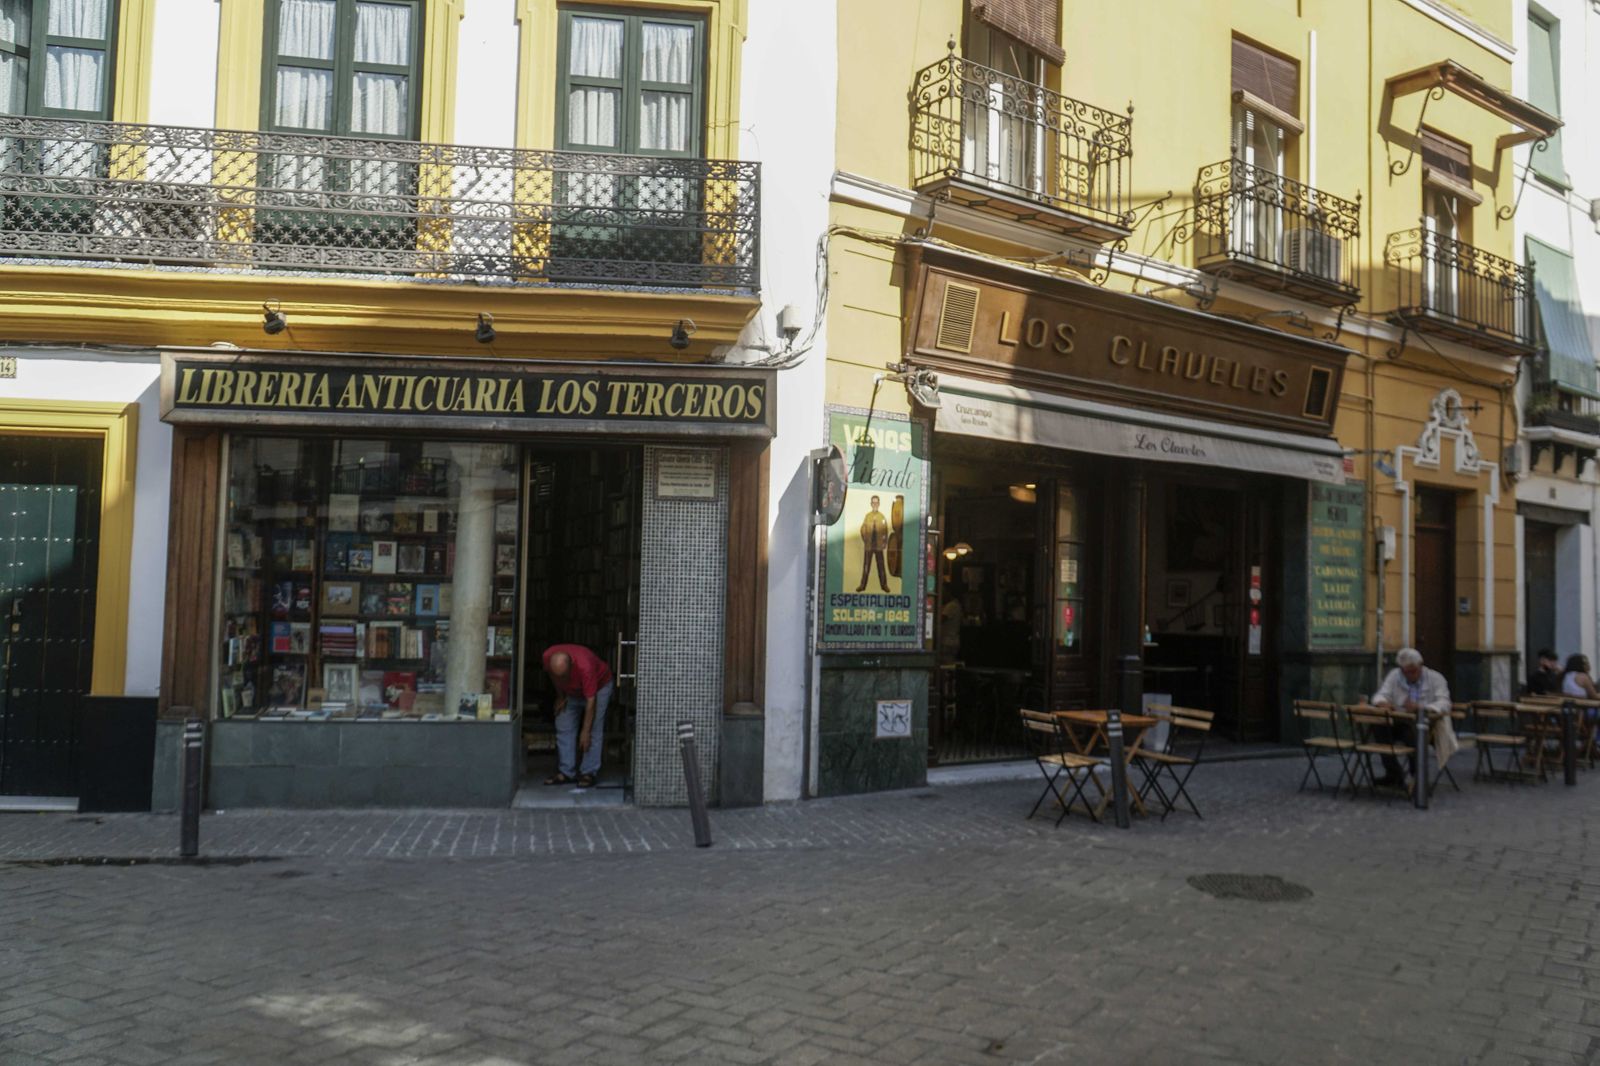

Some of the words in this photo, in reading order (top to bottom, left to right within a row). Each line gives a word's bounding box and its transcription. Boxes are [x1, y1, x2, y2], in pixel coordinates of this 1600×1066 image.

[999, 310, 1076, 354] LOS
[1111, 335, 1289, 397] CLAVELES
[176, 368, 331, 408] LIBRERIA
[336, 374, 525, 413] ANTICUARIA
[537, 379, 599, 415] LOS
[606, 381, 764, 419] TERCEROS
[843, 423, 912, 452] VINOS
[1134, 433, 1157, 451] Los
[1160, 436, 1207, 457] Claveles
[830, 594, 911, 609] ESPECIALIDAD
[832, 608, 876, 622] SOLERA
[885, 610, 910, 623] 1845
